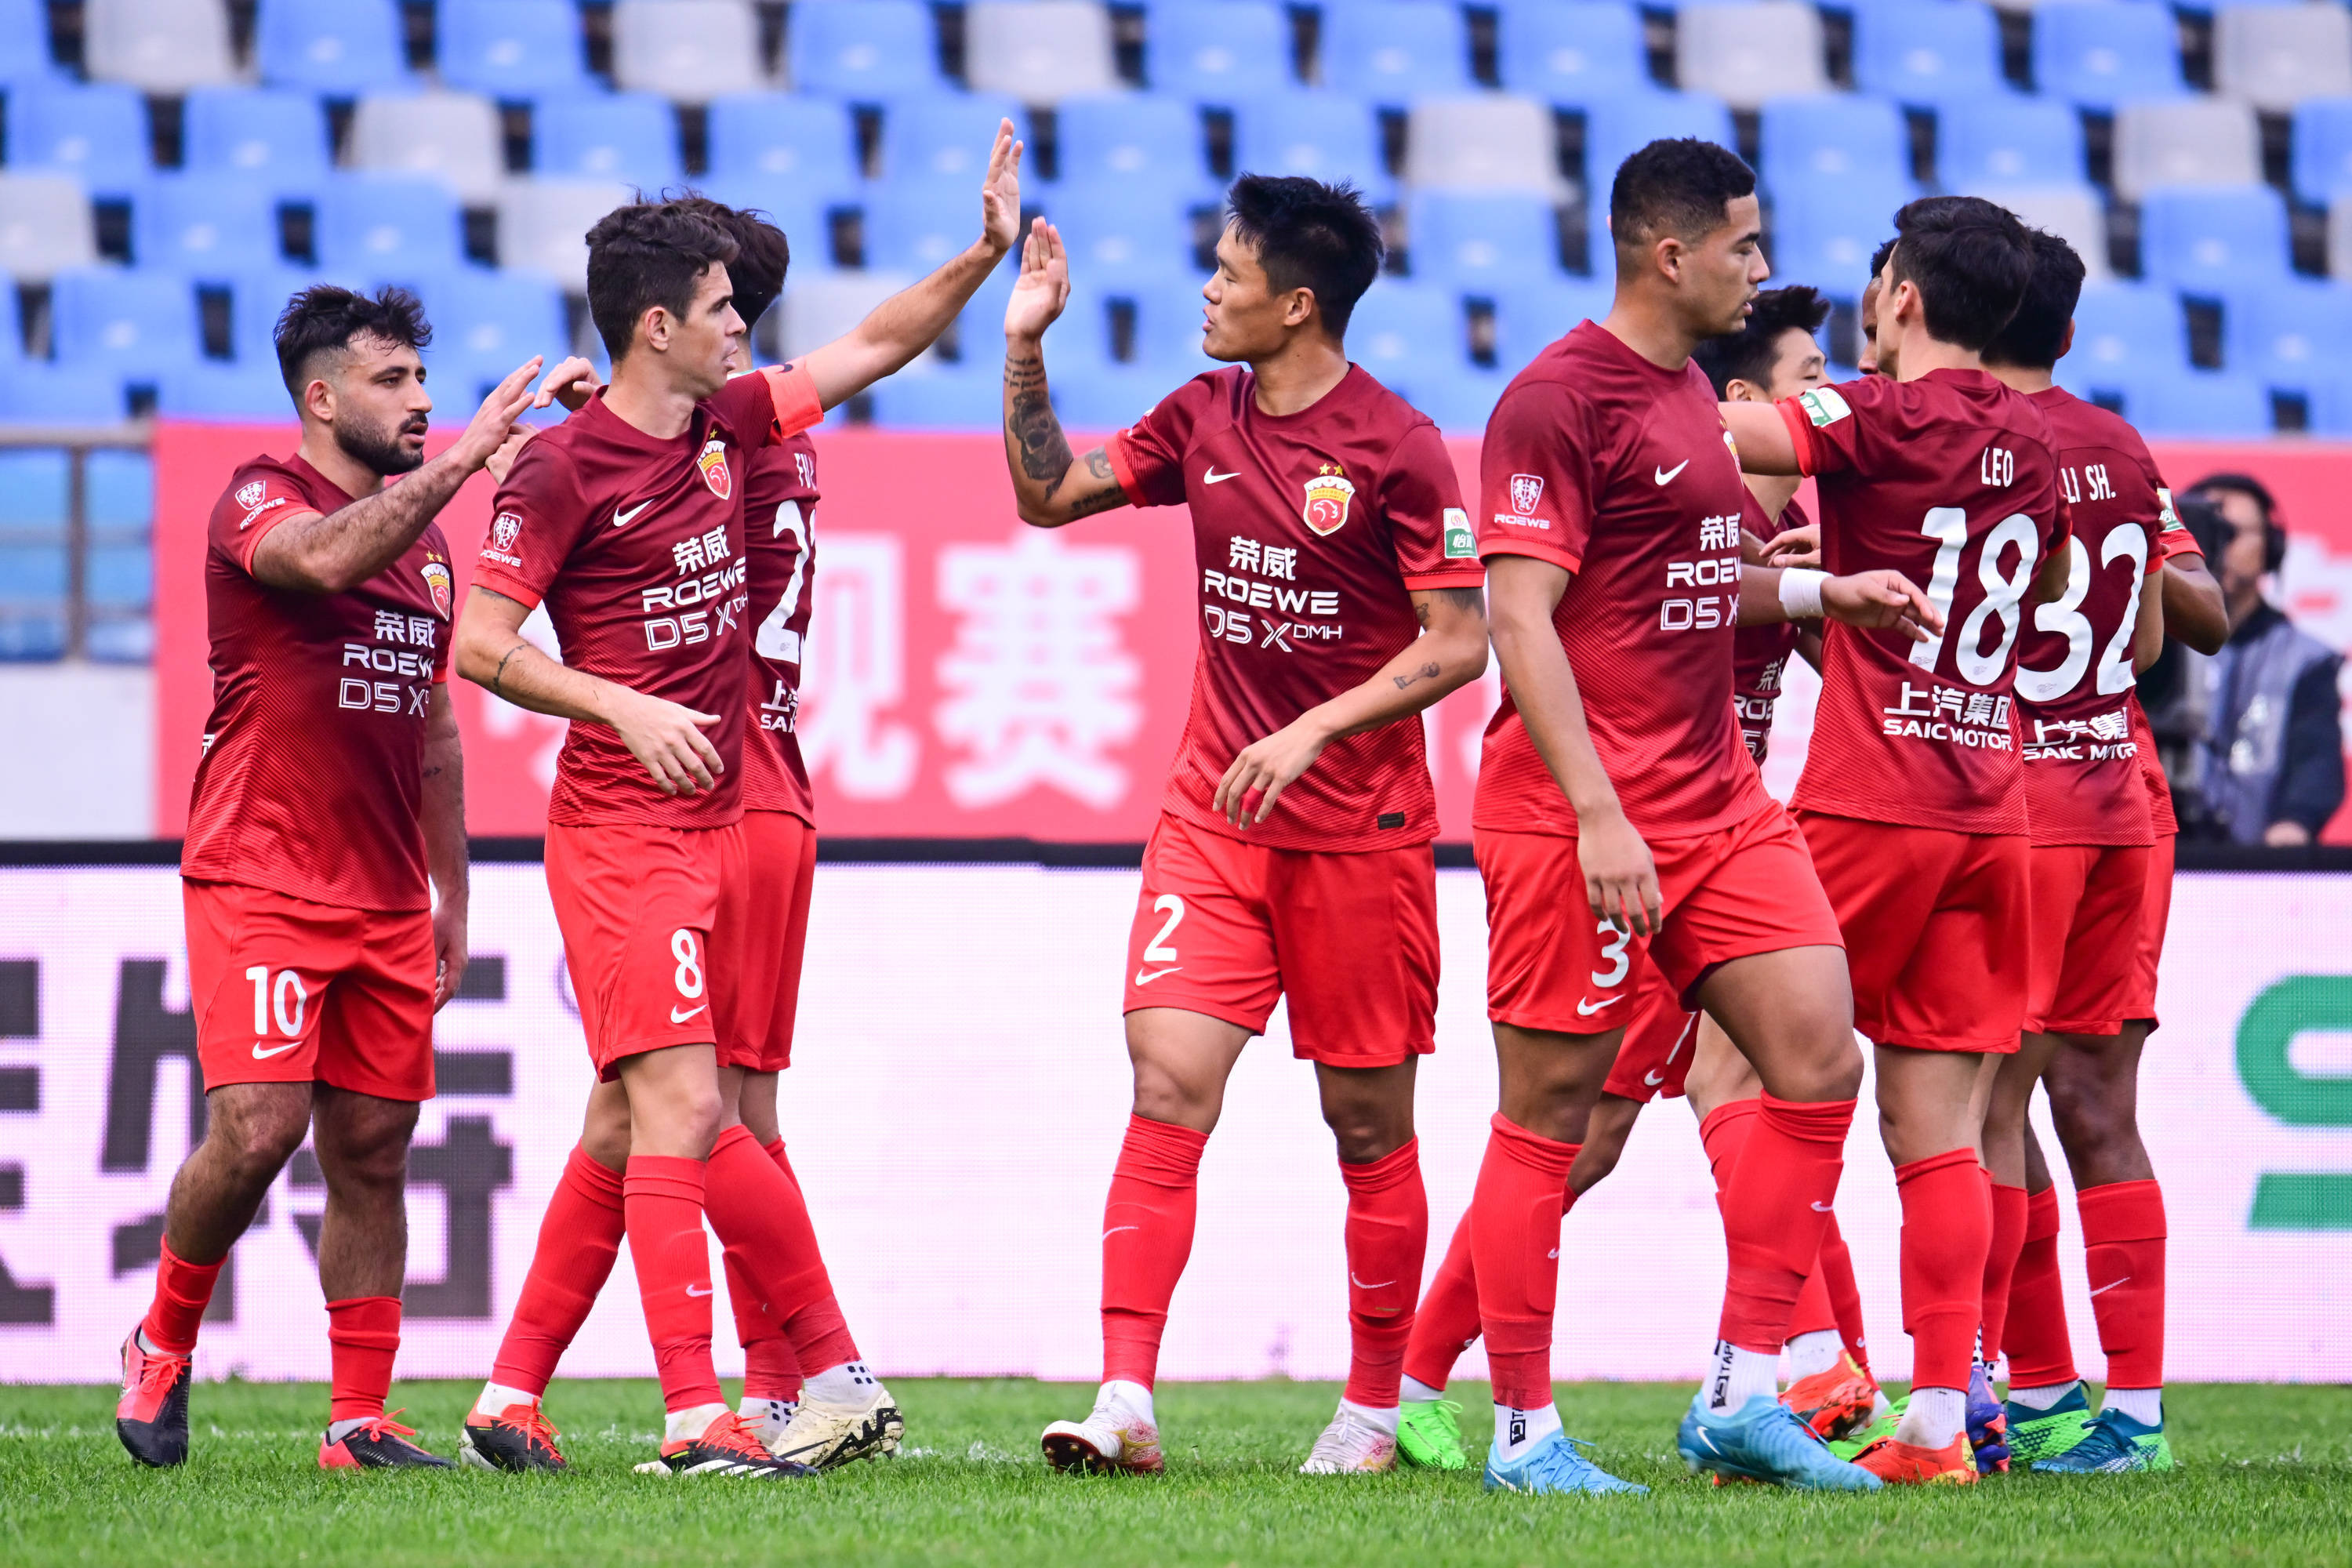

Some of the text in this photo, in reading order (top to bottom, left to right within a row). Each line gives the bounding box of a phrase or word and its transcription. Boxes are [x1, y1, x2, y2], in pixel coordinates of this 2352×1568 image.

[1981, 447, 2013, 488] LEO
[2060, 464, 2116, 503] LI SH.
[240, 497, 285, 530] ROEWE
[1494, 514, 1549, 529] ROEWE
[672, 524, 731, 575] 荣威
[1229, 535, 1297, 581] 荣威
[642, 557, 746, 612] ROEWE
[756, 499, 816, 665] 2
[1204, 568, 1339, 615] ROEWE
[1907, 507, 2038, 685] 18
[373, 609, 435, 648] 荣威
[2013, 522, 2147, 702] 32
[1883, 719, 2014, 752] SAIC MOTOR
[2023, 746, 2083, 761] SAIC
[1143, 894, 1185, 962] 2
[671, 928, 702, 999] 8
[1591, 917, 1632, 989] 3
[245, 966, 307, 1037] 10
